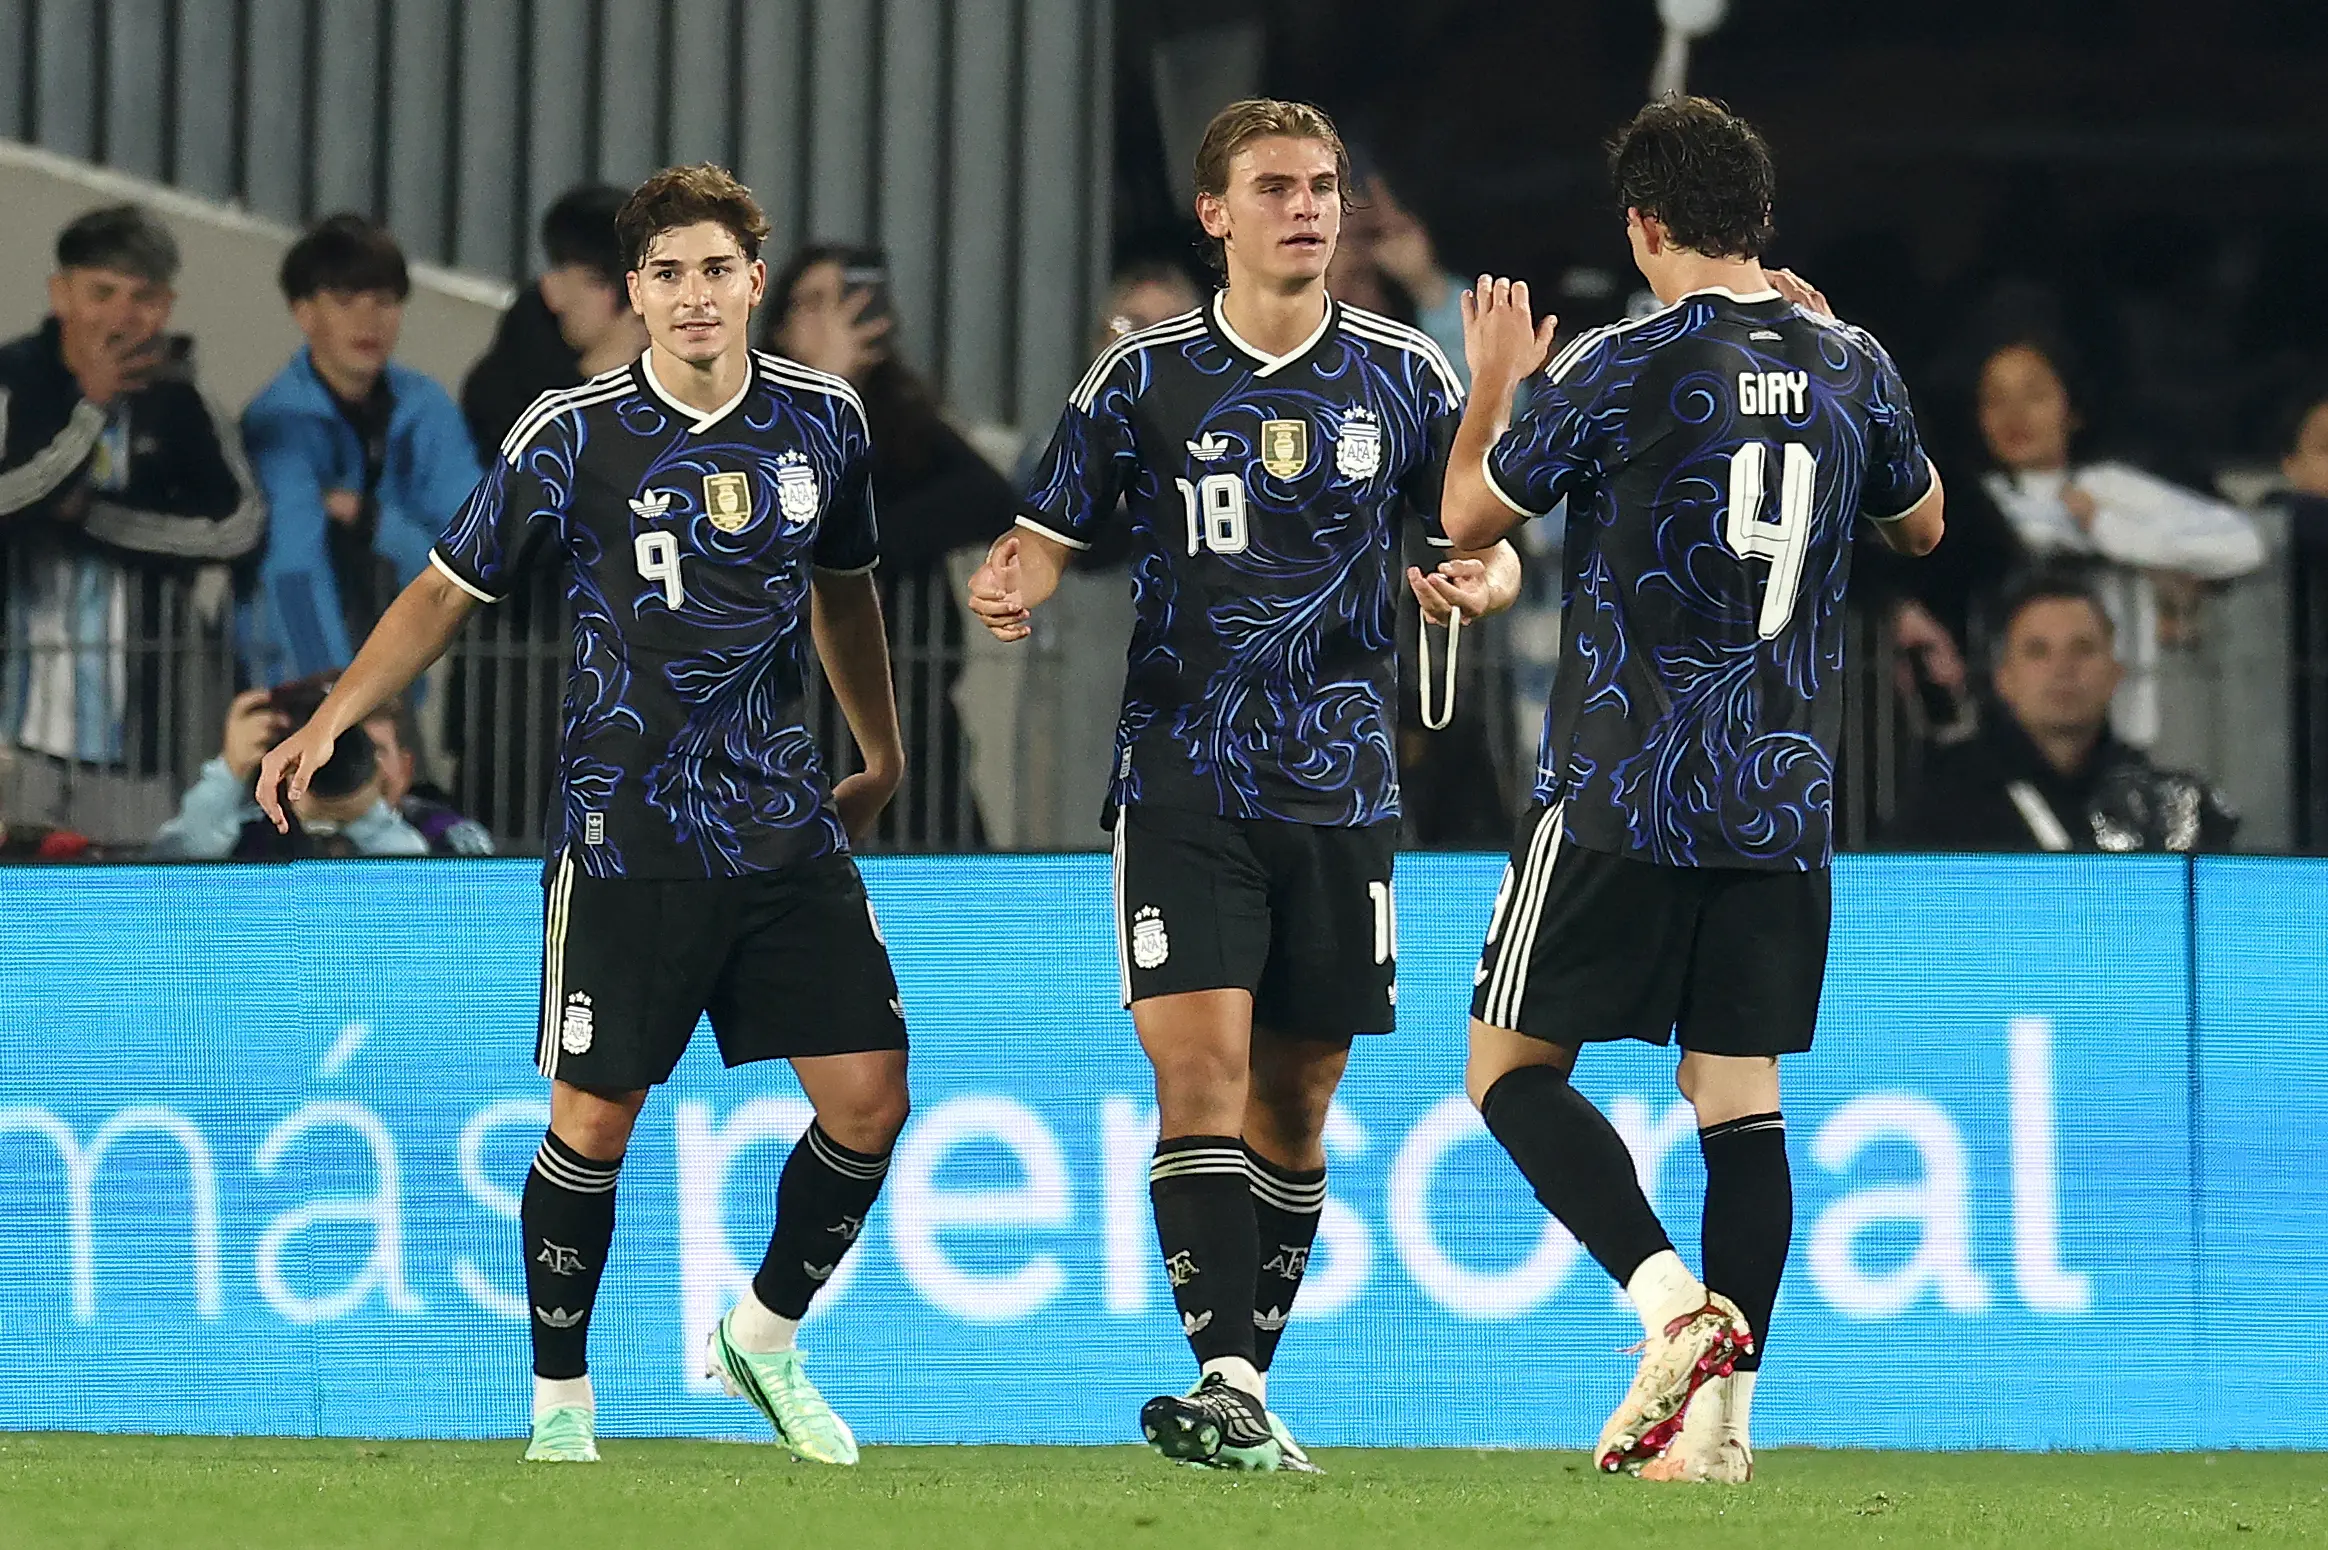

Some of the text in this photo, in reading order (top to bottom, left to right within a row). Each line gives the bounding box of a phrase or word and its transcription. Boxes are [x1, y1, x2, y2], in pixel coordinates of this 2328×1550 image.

[1738, 370, 1808, 415] GIAY
[1175, 474, 1249, 557] 18
[1726, 442, 1817, 640] 4
[634, 530, 684, 611] 9
[1369, 881, 1397, 965] 1
